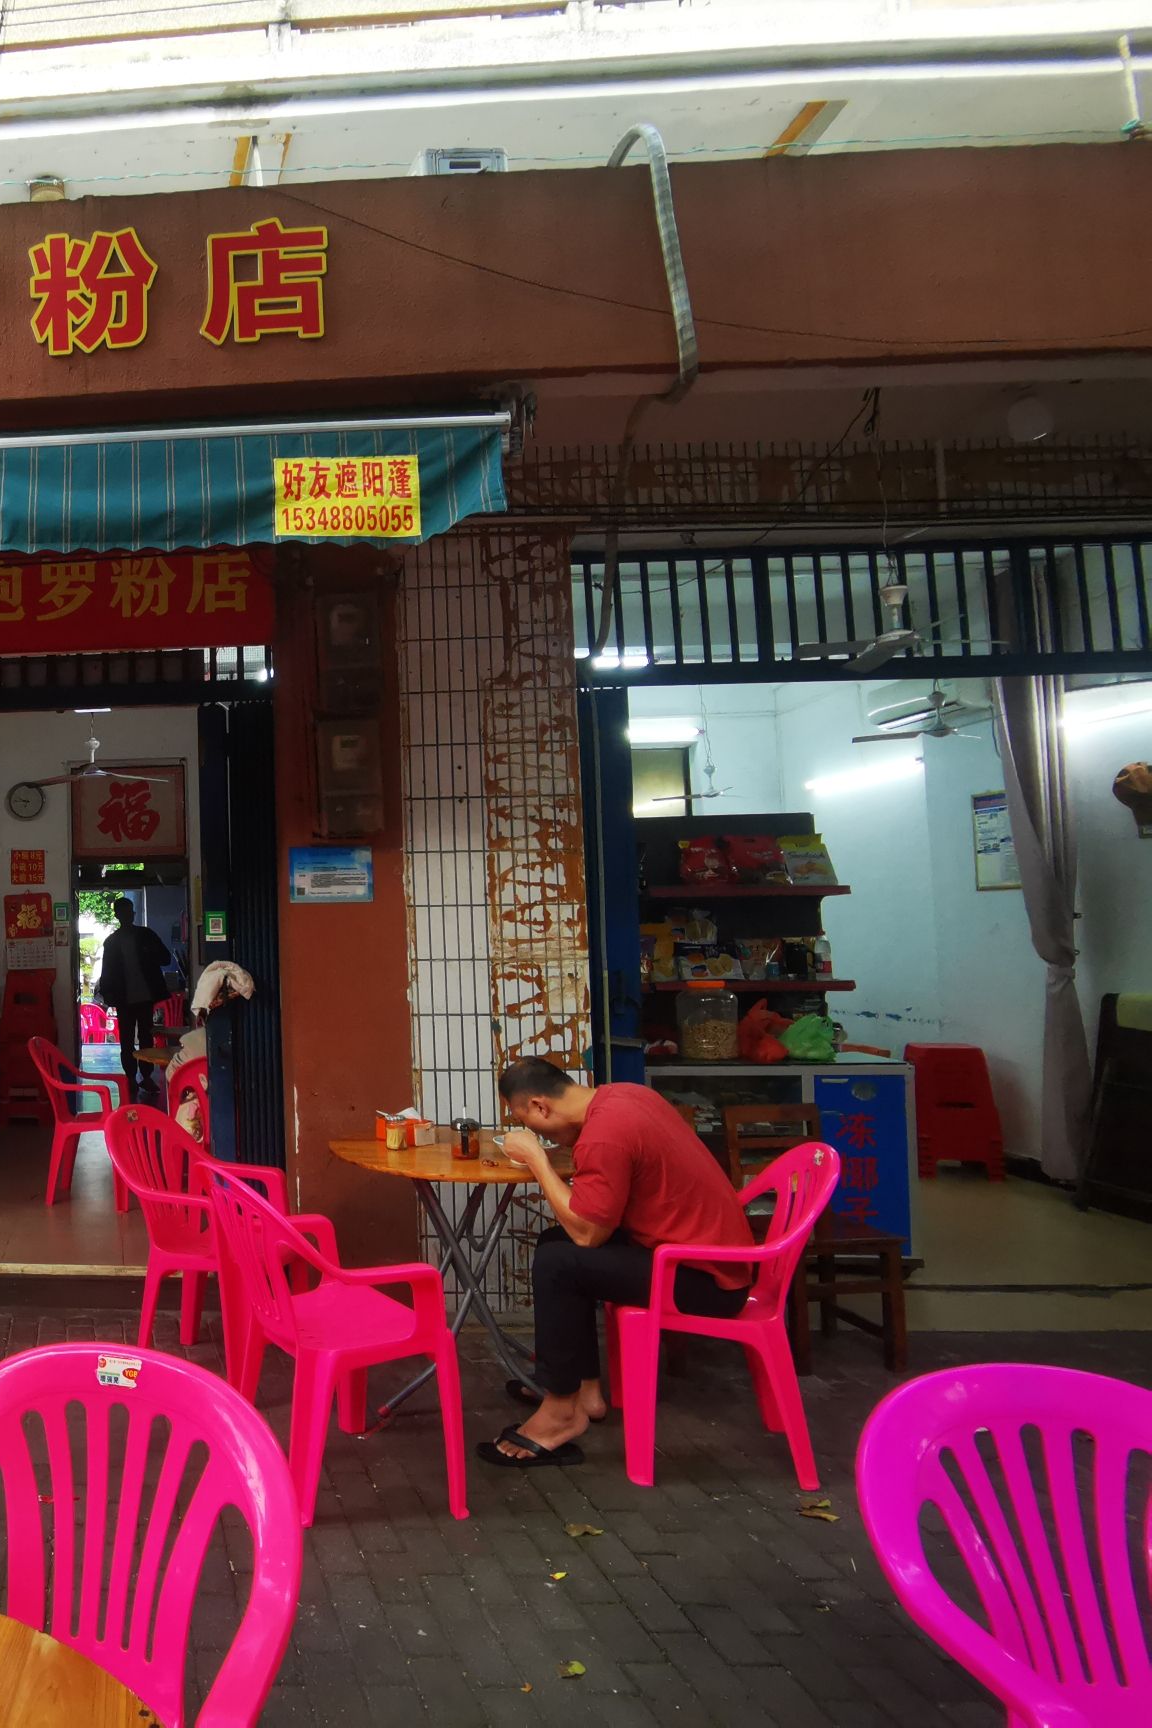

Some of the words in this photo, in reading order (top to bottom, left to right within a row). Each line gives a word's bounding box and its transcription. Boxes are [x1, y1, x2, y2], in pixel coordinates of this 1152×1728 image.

[282, 459, 412, 501] 好友遮阳蓬
[282, 505, 414, 532] 15348805055
[97, 781, 161, 843] 福
[835, 1112, 879, 1223] 冻椰子
